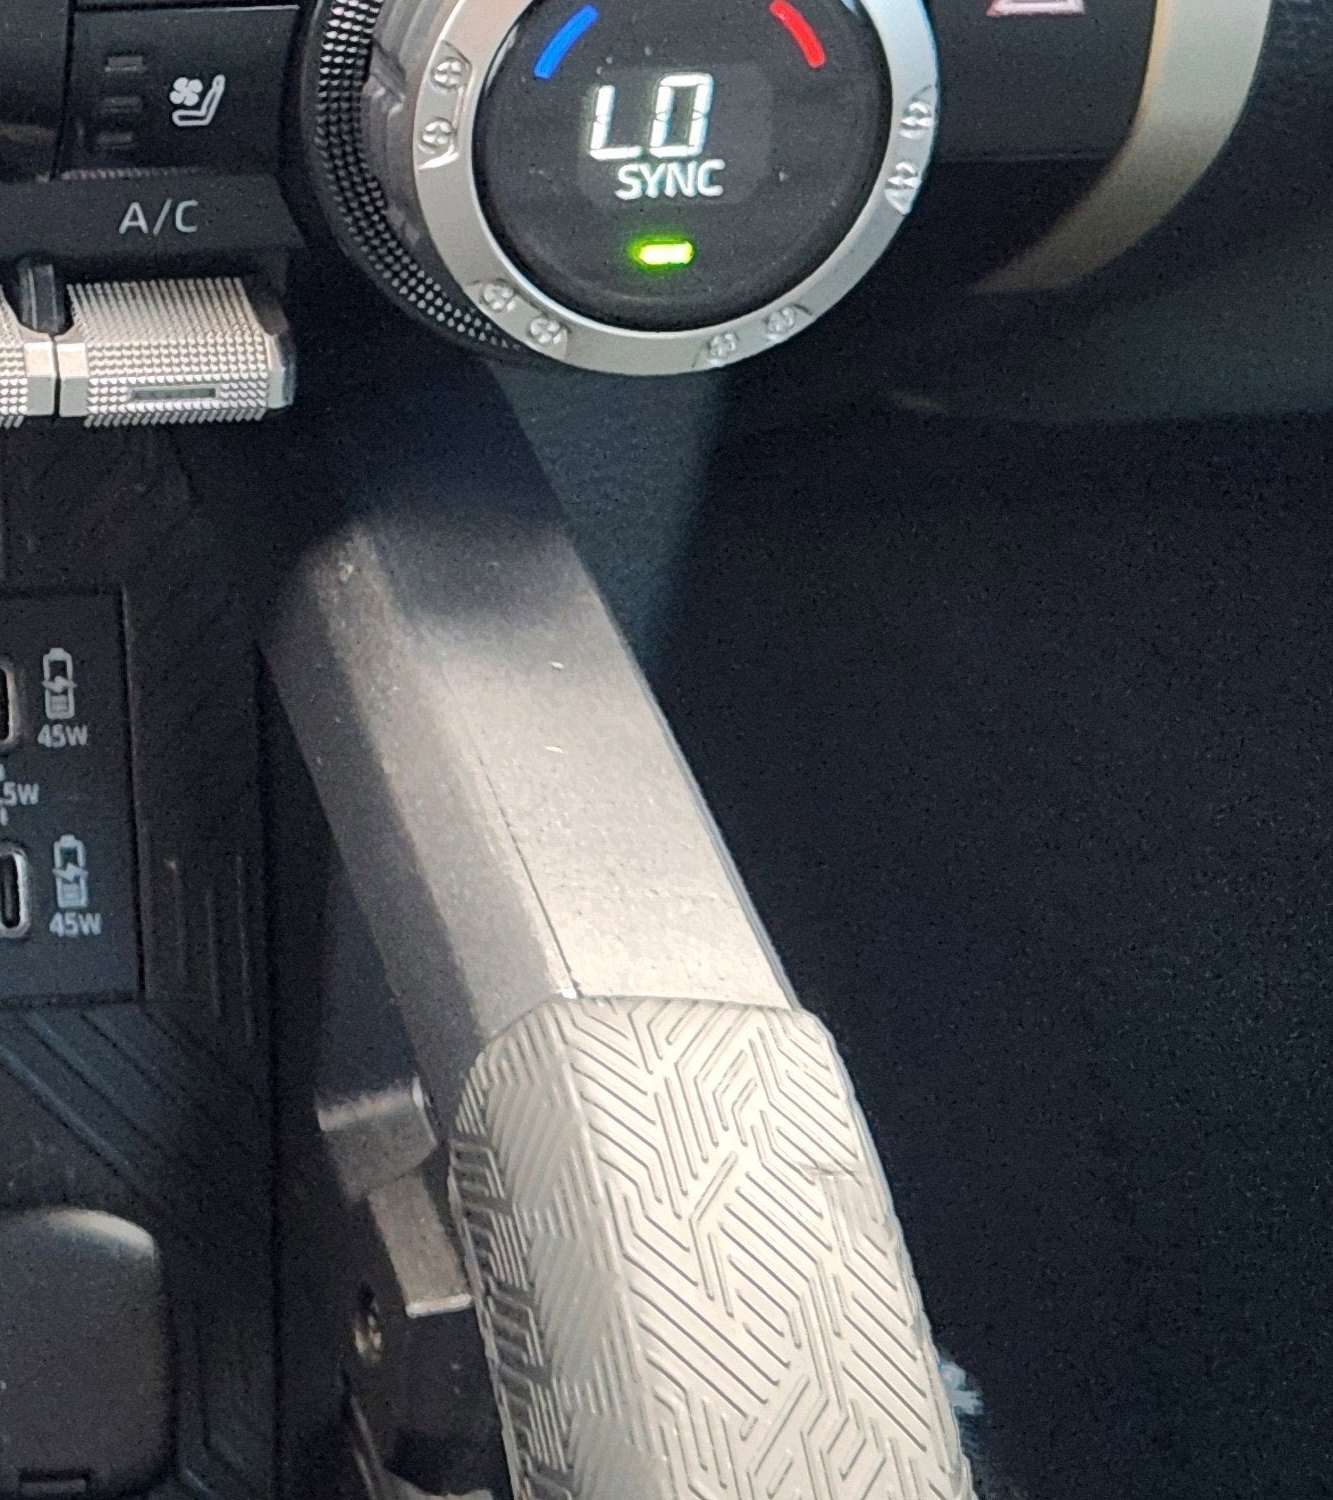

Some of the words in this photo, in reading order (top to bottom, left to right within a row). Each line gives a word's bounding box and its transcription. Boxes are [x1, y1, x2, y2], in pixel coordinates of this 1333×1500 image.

[589, 72, 715, 161] LO
[615, 158, 726, 201] SYNC
[118, 198, 199, 236] A/C
[37, 723, 89, 748] 45W
[49, 911, 103, 937] 45W
